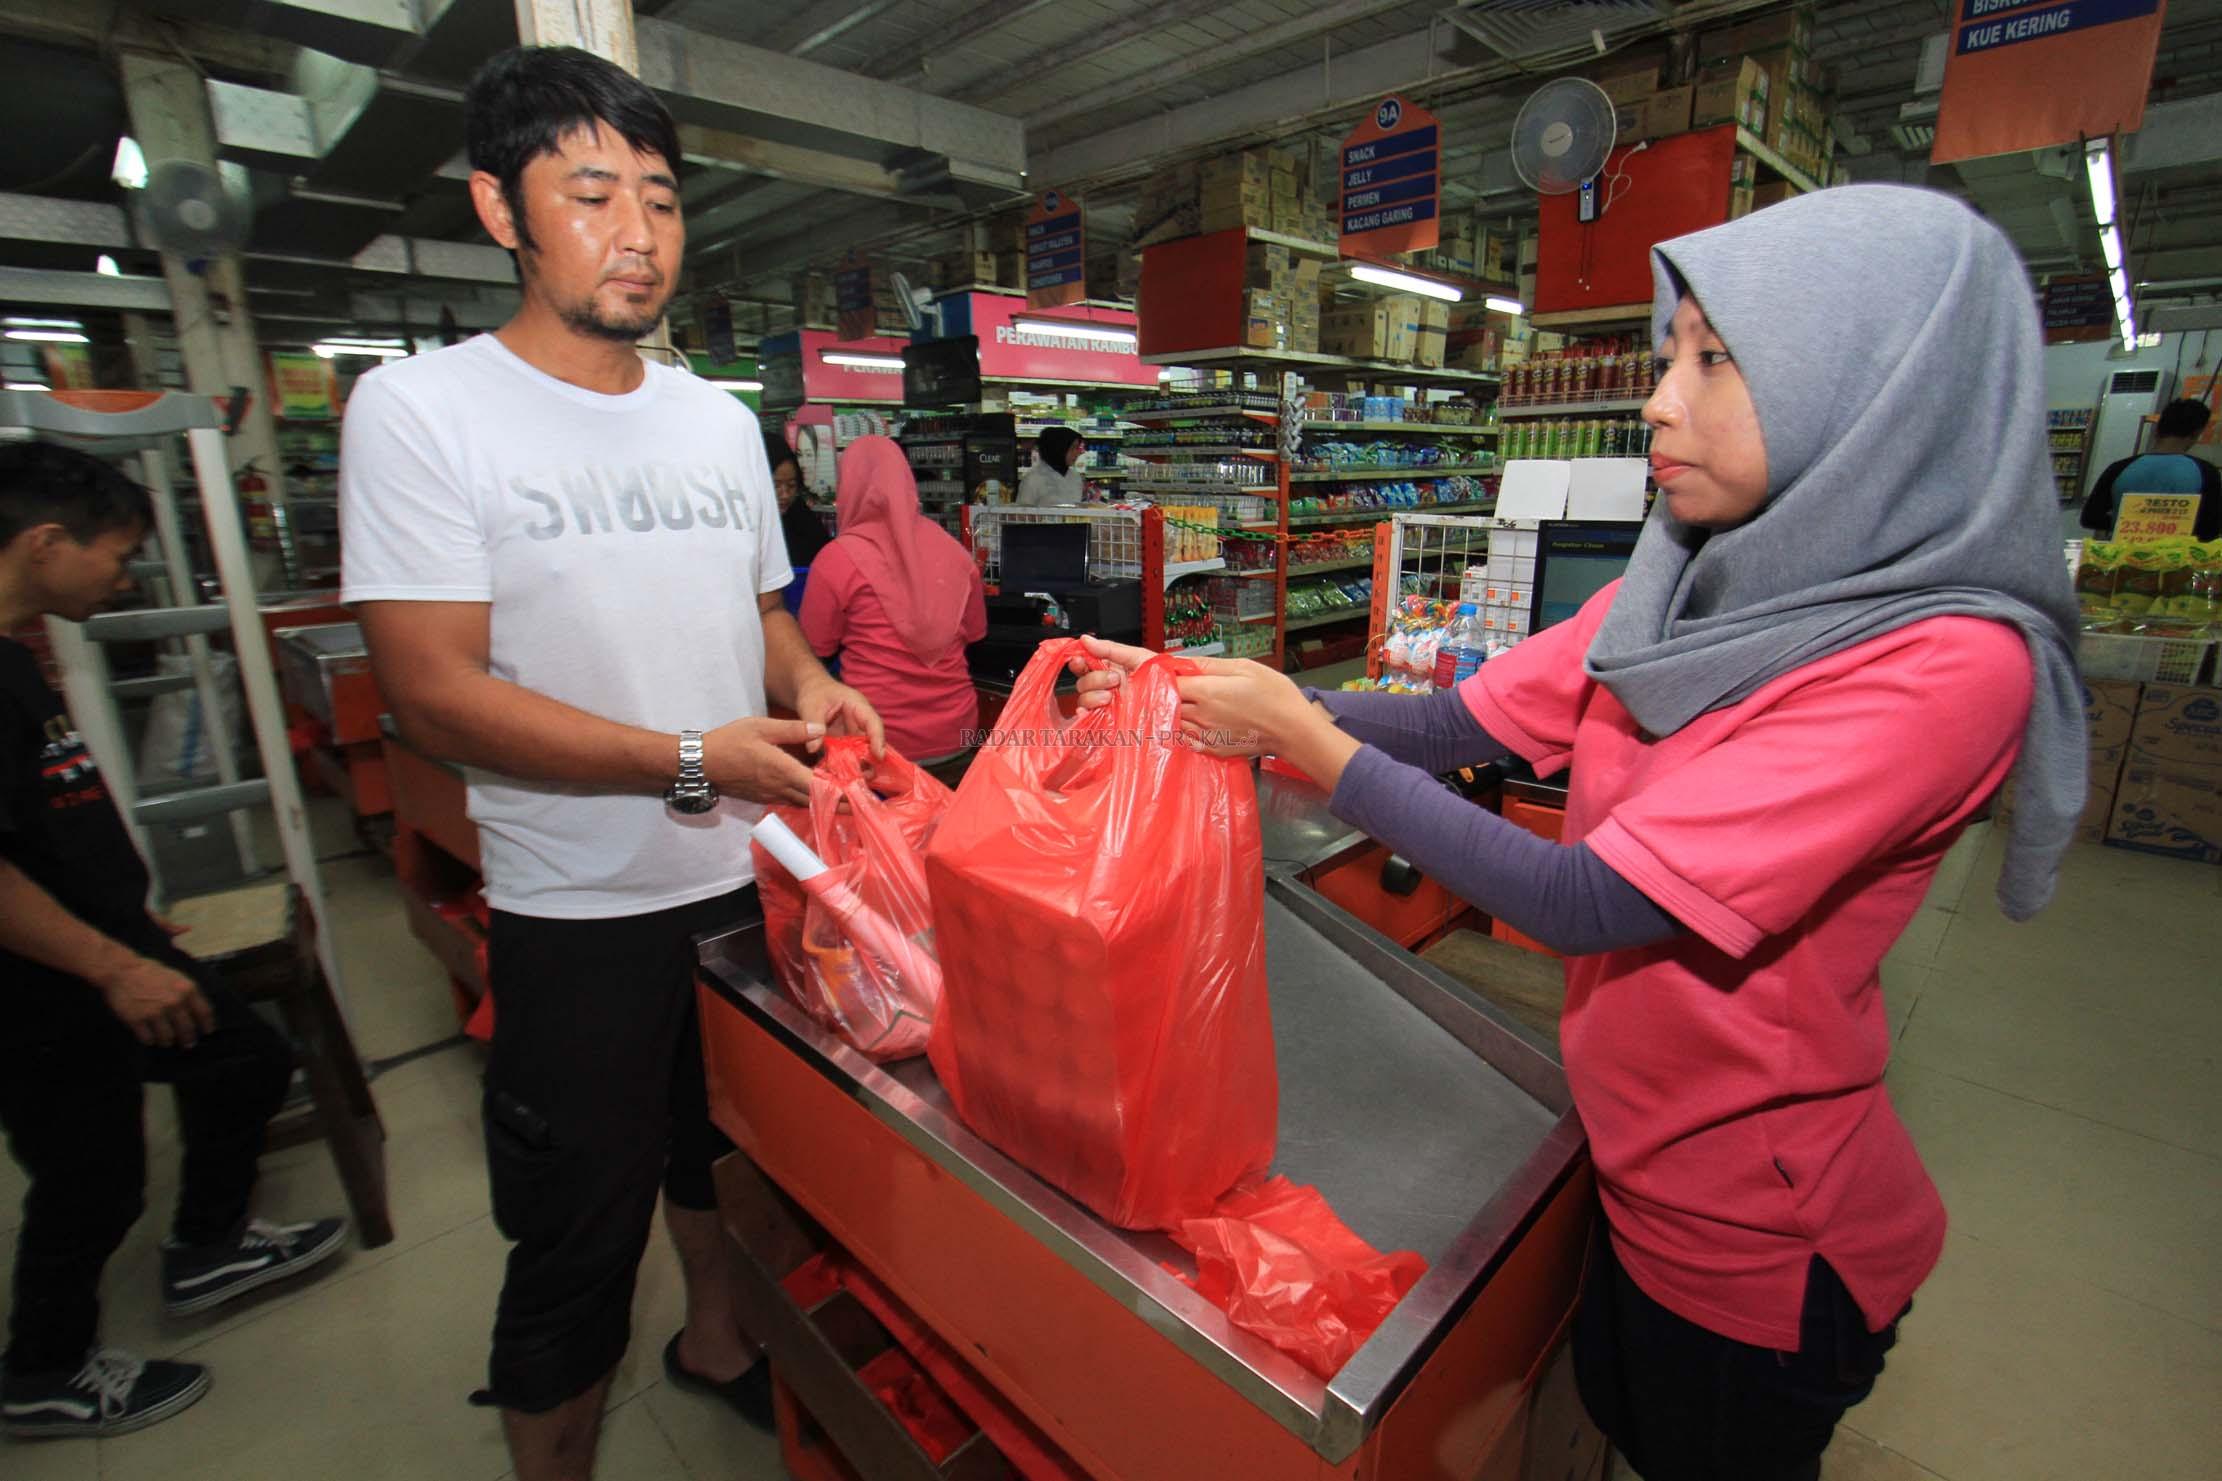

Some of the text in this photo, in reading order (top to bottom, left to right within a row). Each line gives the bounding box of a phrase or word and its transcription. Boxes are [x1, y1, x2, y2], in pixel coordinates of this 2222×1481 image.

[1967, 9, 2071, 49] KUE KERING
[1378, 105, 1398, 124] 9A
[1348, 145, 1376, 164] SNACK
[1348, 169, 1373, 186] JELLY
[1347, 191, 1380, 208] PERMEN
[1347, 207, 1413, 231] KACANG GARING
